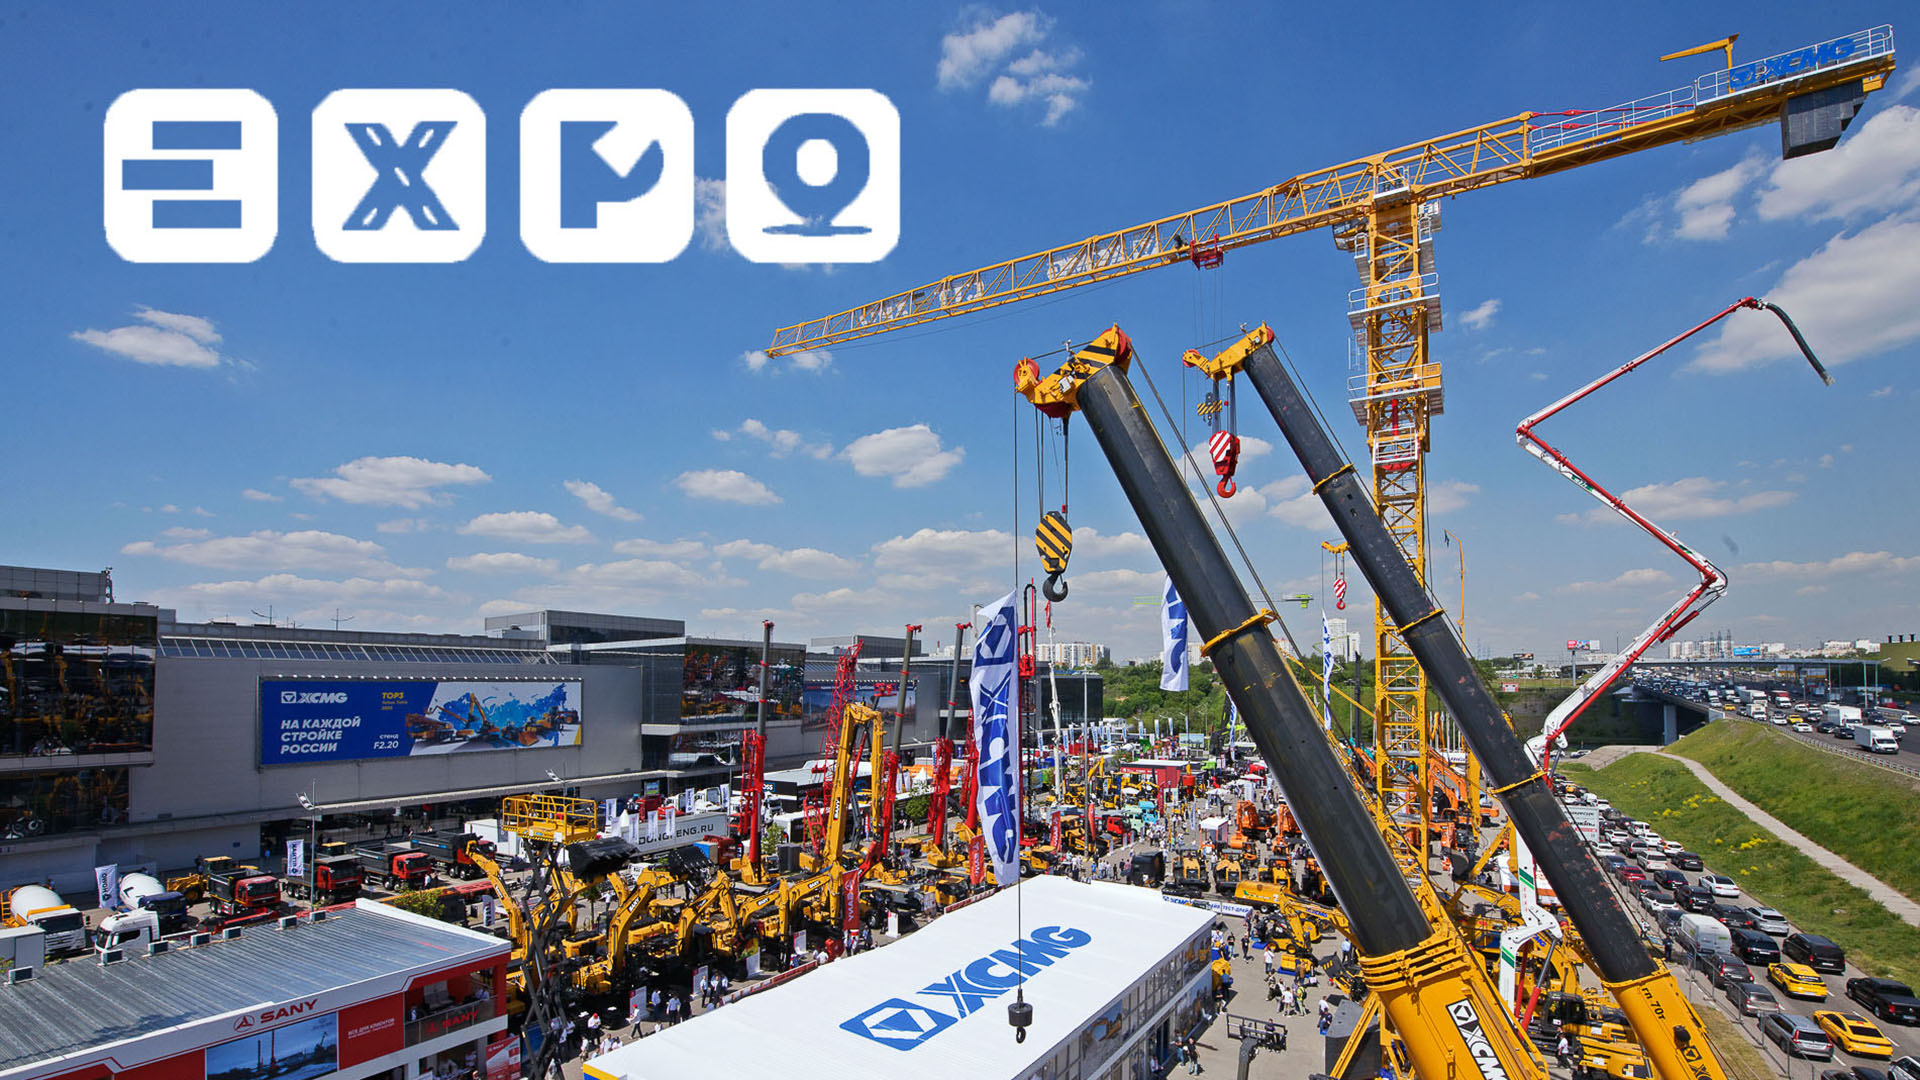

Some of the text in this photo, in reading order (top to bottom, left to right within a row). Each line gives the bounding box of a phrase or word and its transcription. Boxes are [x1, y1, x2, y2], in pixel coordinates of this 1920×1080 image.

[1757, 38, 1856, 81] XCMG
[297, 692, 348, 704] XCMG
[281, 715, 361, 730] НА КАЖДОЙ
[281, 728, 343, 742] СТРОЙКЕ
[280, 742, 338, 755] РОССИИ
[373, 740, 399, 750] F2.20
[638, 823, 714, 845] DONGENG.RU
[915, 926, 1092, 1019] XCMG
[260, 999, 318, 1024] SANY
